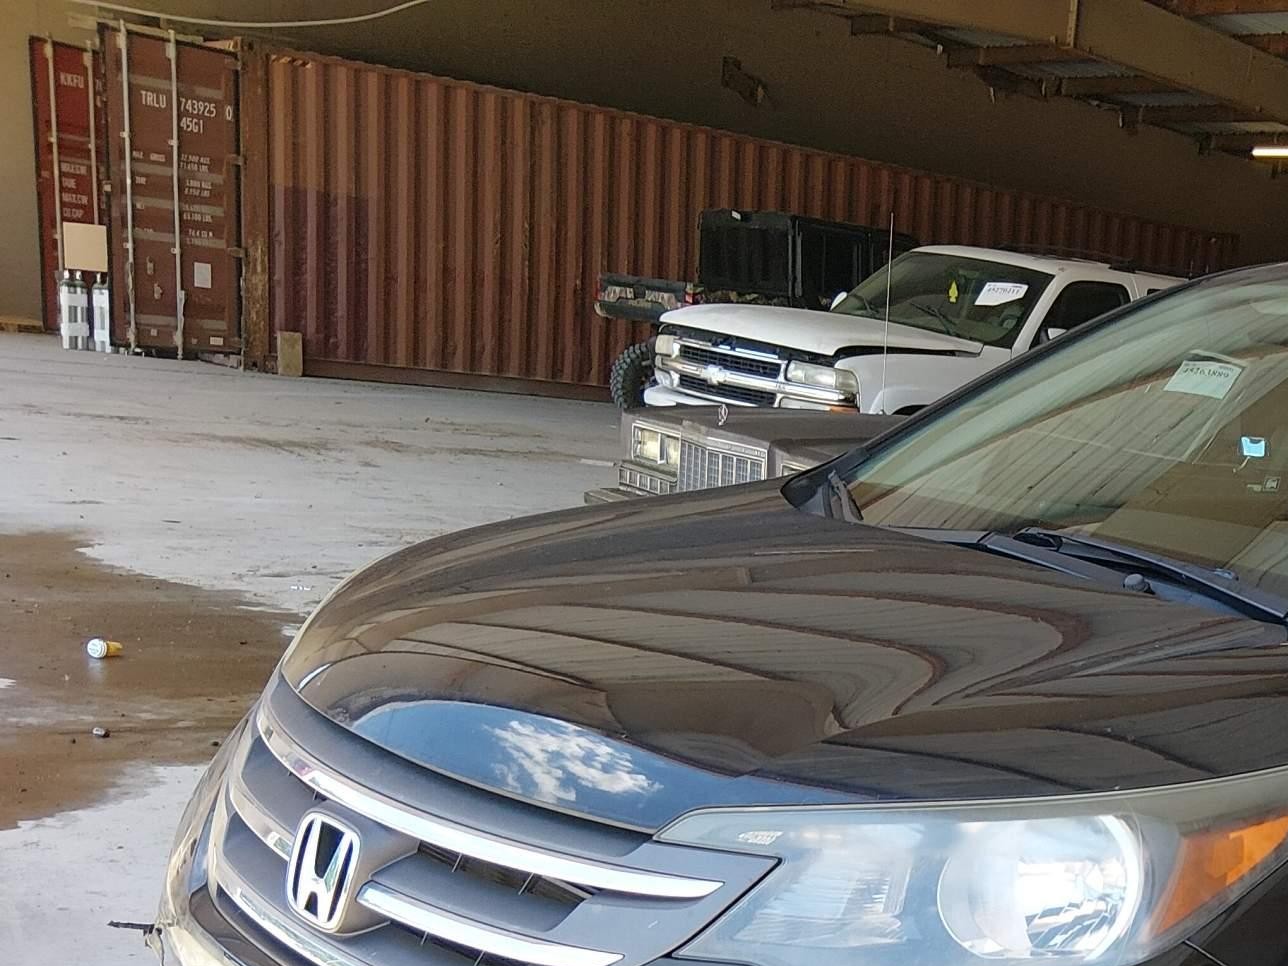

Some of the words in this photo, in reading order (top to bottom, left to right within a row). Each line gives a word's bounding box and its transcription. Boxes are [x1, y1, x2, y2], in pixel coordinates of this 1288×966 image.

[140, 90, 167, 109] TRLU
[179, 98, 217, 118] 743925
[180, 116, 204, 134] 45G1
